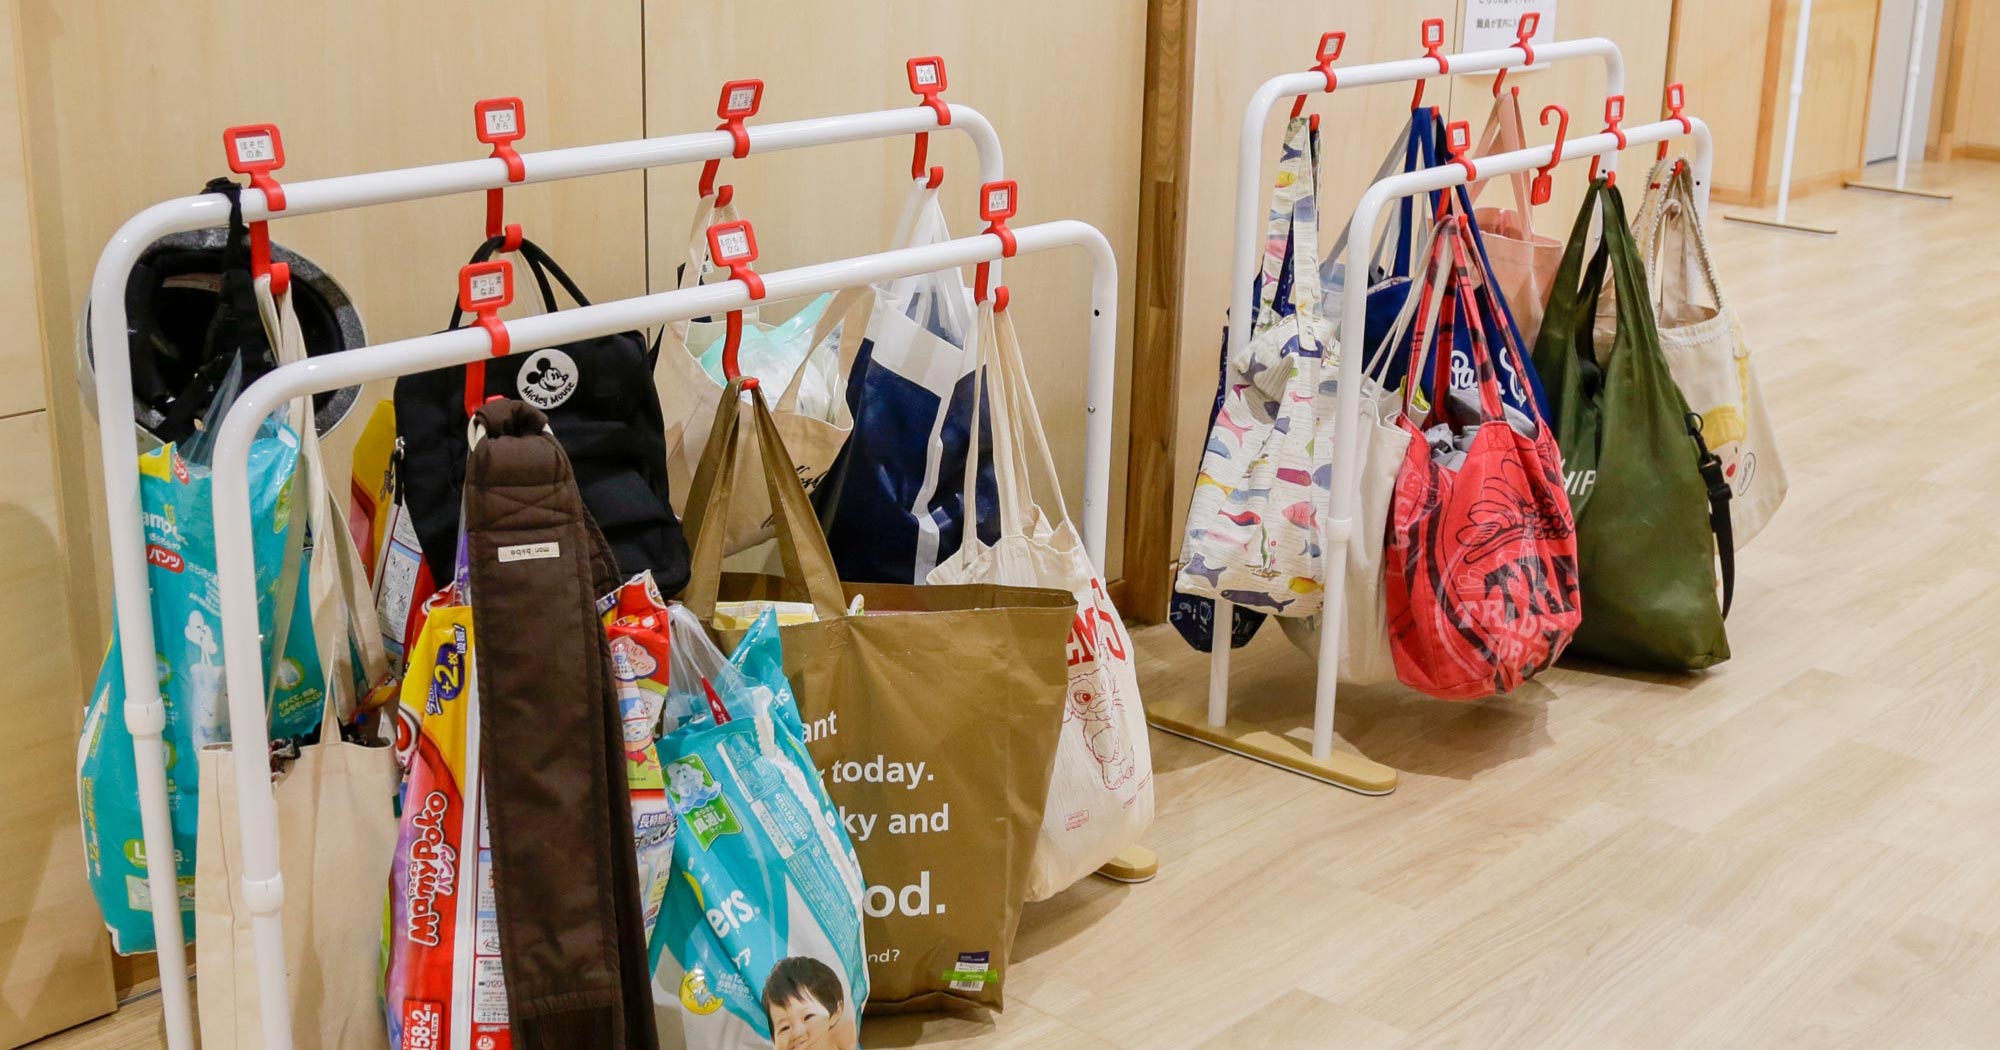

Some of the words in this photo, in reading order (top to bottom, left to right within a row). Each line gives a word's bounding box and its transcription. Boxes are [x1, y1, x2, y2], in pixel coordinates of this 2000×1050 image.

[522, 385, 548, 407] Mickey
[550, 382, 575, 405] Mouse
[149, 548, 182, 569] パンツ
[802, 710, 838, 744] ant
[832, 754, 935, 790] today.
[839, 805, 878, 842] ky
[888, 803, 949, 834] and
[409, 792, 448, 946] MamyPoko
[437, 845, 456, 895] パンツ
[862, 870, 946, 918] od.
[867, 948, 901, 963] nd?
